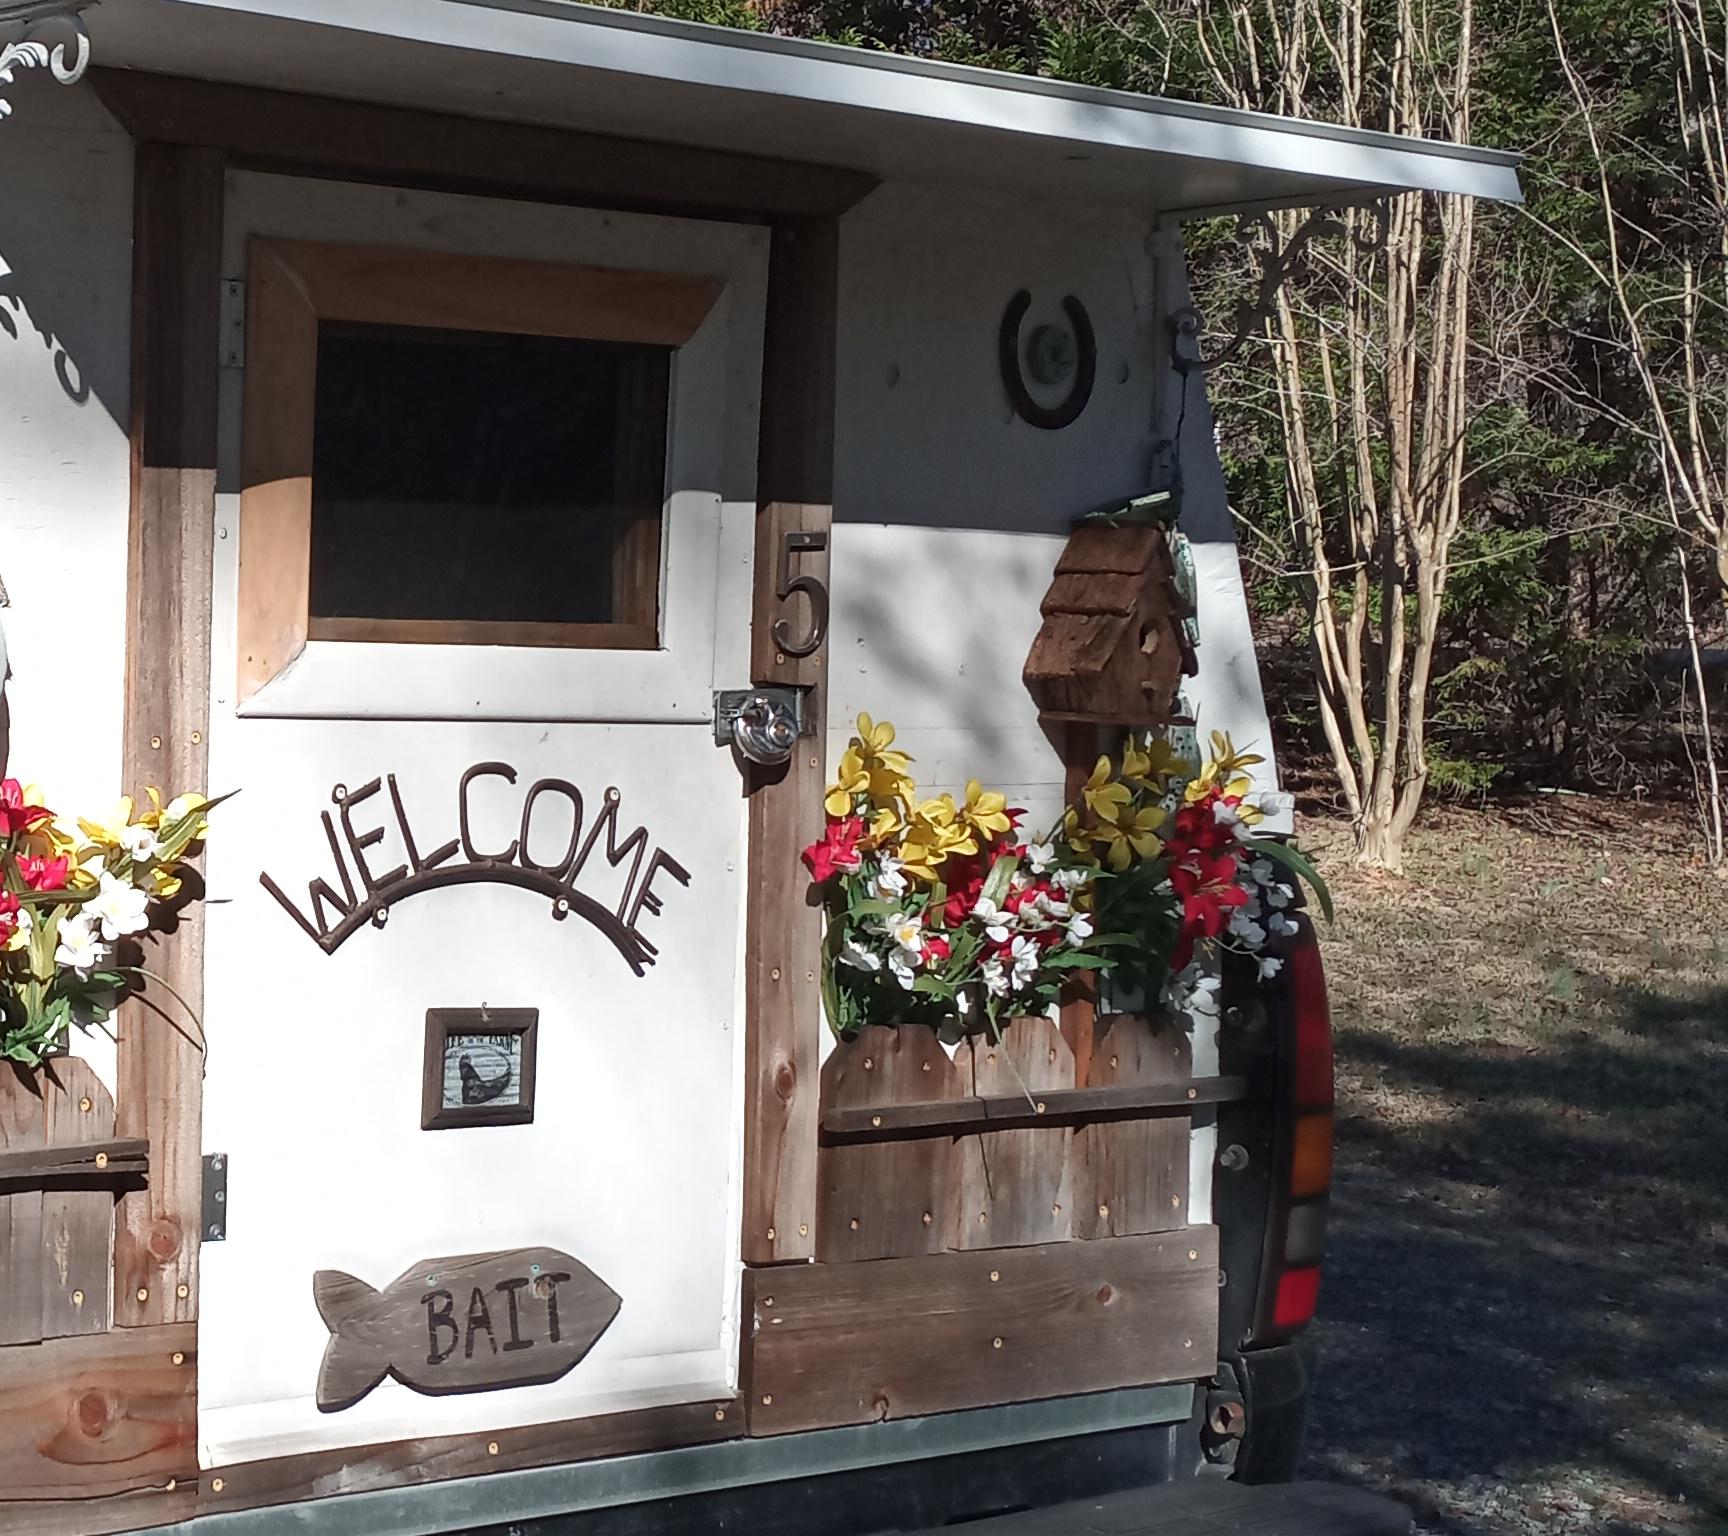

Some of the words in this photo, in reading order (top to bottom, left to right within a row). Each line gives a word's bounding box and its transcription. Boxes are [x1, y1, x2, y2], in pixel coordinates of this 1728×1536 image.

[771, 531, 830, 659] 5
[259, 762, 692, 970] WELCOME
[421, 1272, 572, 1366] BAIT
